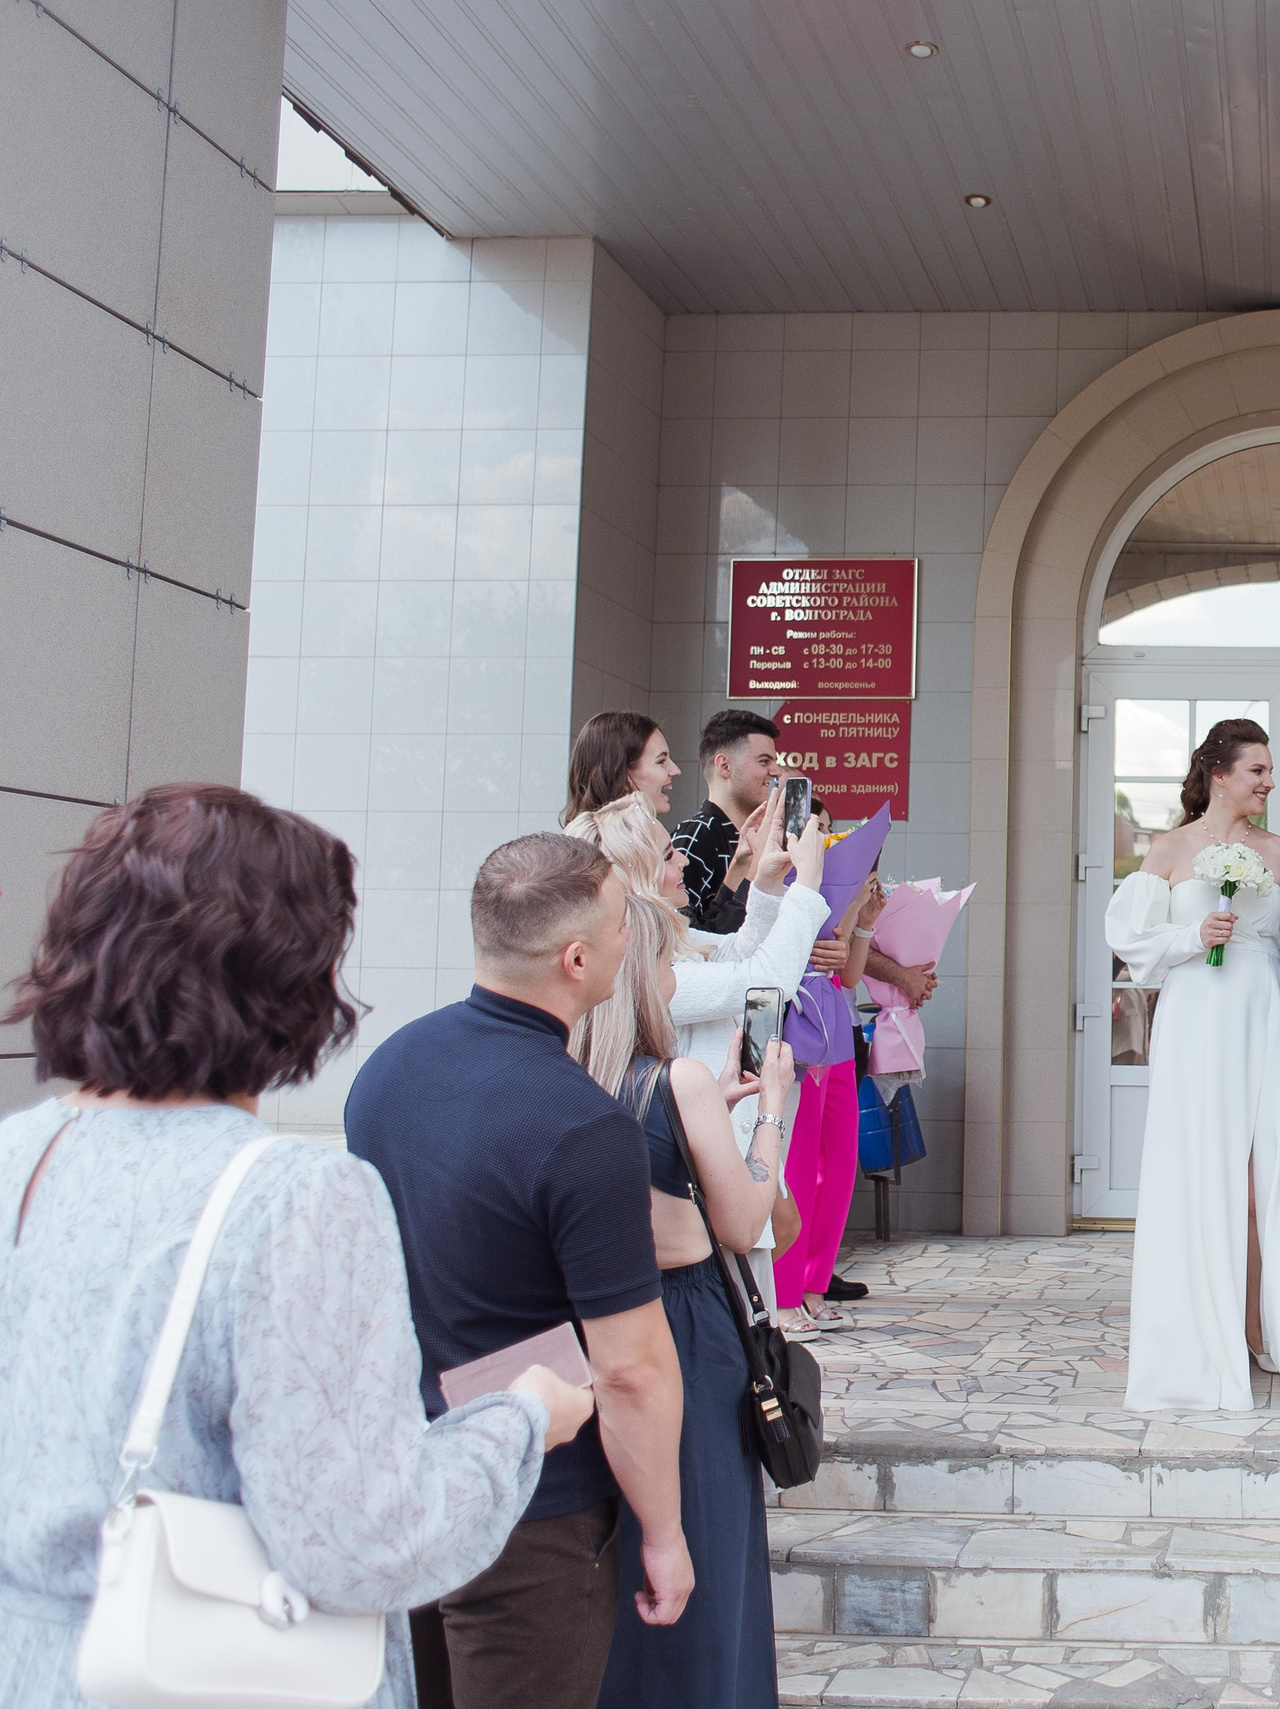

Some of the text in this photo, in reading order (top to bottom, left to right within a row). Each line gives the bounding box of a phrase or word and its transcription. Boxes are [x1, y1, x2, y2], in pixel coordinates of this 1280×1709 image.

[782, 568, 865, 581] ОТДЕЛ ЗАГС
[758, 582, 887, 595] АДМИНИСТРАЦИИ
[746, 594, 899, 608] СОВЕТСКОГО РАЙОНА
[770, 609, 874, 622] г. ВОЛГОГРАДА
[786, 629, 857, 640] Режим работы:
[749, 646, 764, 655] ПН
[771, 646, 786, 655] СБ
[811, 644, 844, 655] 08-30
[845, 648, 858, 656] до
[860, 644, 893, 655] 17-30
[749, 660, 792, 671] Перерыв
[811, 658, 844, 669] 13-00
[845, 662, 858, 670] до
[860, 658, 893, 669] 14-00
[749, 679, 876, 690] Выходной: воскресенье
[782, 712, 901, 725] с ПОНЕДЕЛЬНИКА
[820, 727, 901, 739] по ПЯТНИЦУ
[825, 756, 837, 767] в
[843, 752, 899, 768] ЗАГС
[850, 782, 899, 795] здания)
